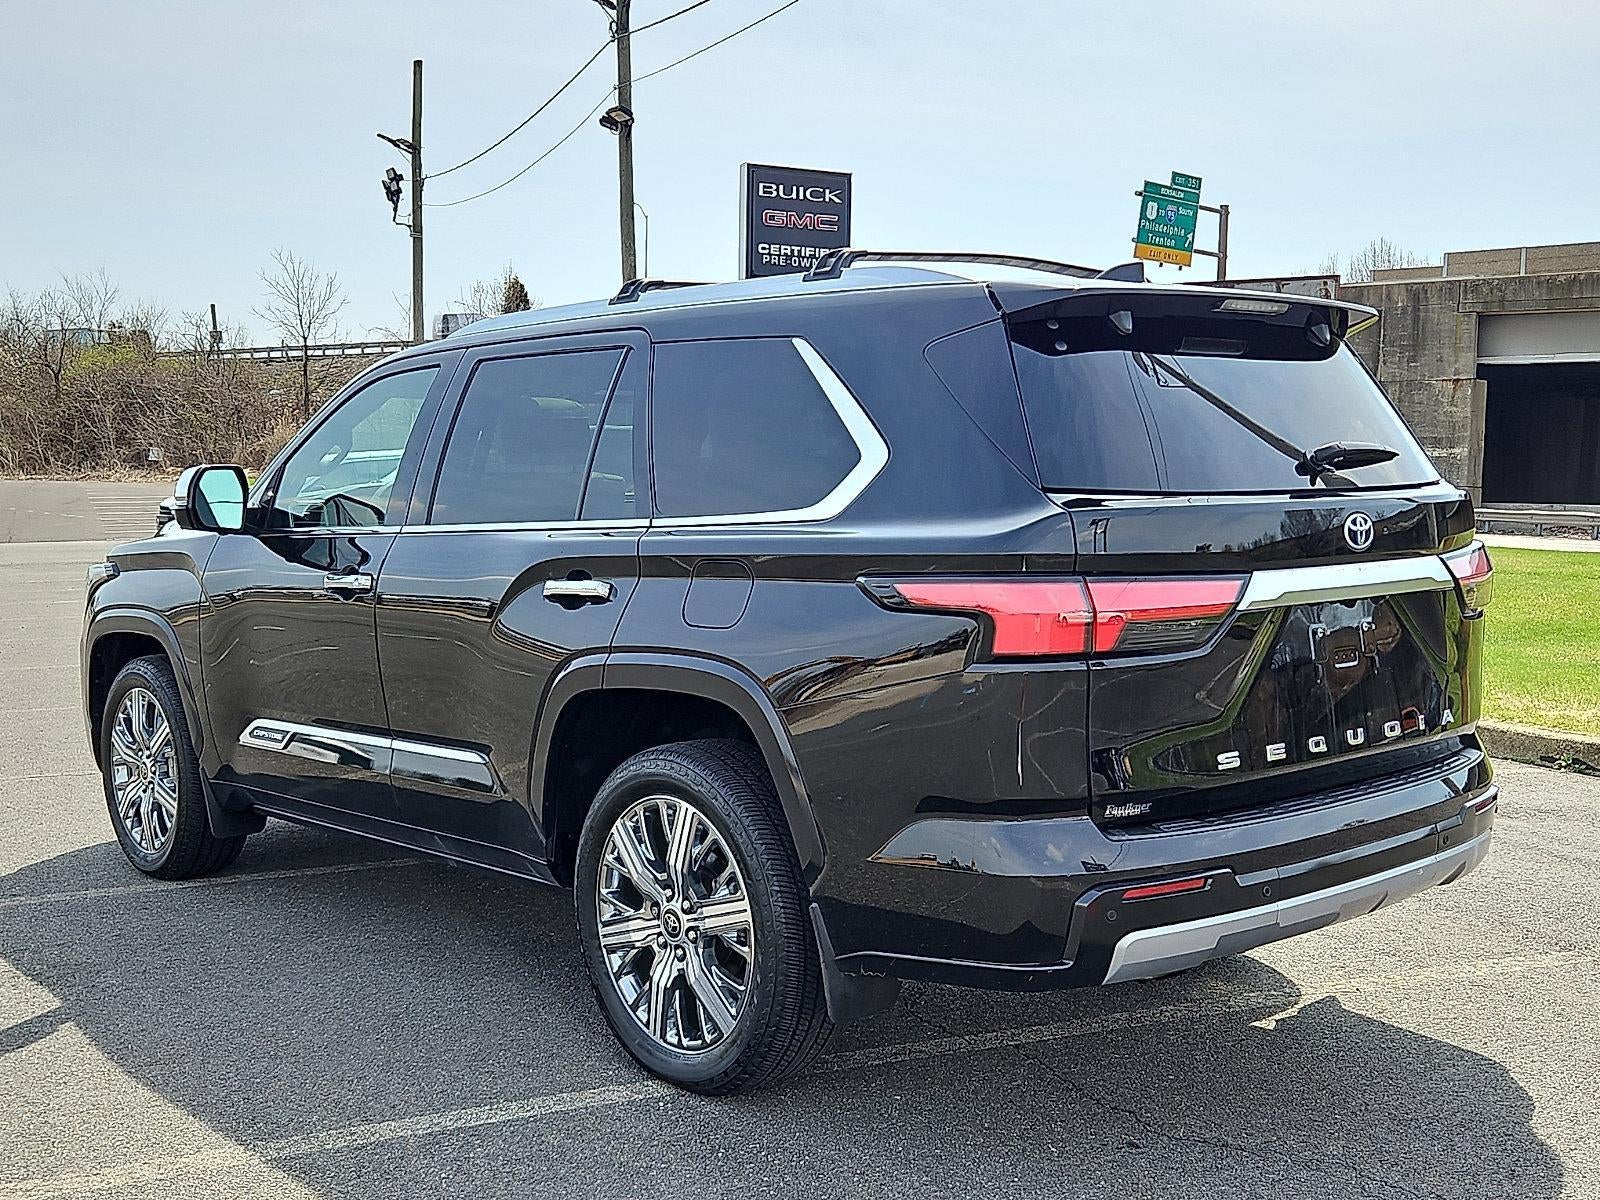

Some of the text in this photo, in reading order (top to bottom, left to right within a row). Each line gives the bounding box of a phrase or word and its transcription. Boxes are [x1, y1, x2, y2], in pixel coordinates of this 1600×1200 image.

[1187, 178, 1200, 189] 351
[758, 182, 843, 204] BUICK
[762, 210, 839, 232] GMC
[1167, 210, 1176, 219] 95
[1140, 219, 1185, 237] Philadelphia
[1148, 233, 1176, 247] Trenton
[1149, 249, 1179, 261] EXIT ONLY
[1216, 708, 1455, 771] SEQUOIA
[1103, 802, 1153, 817] Faulkner
